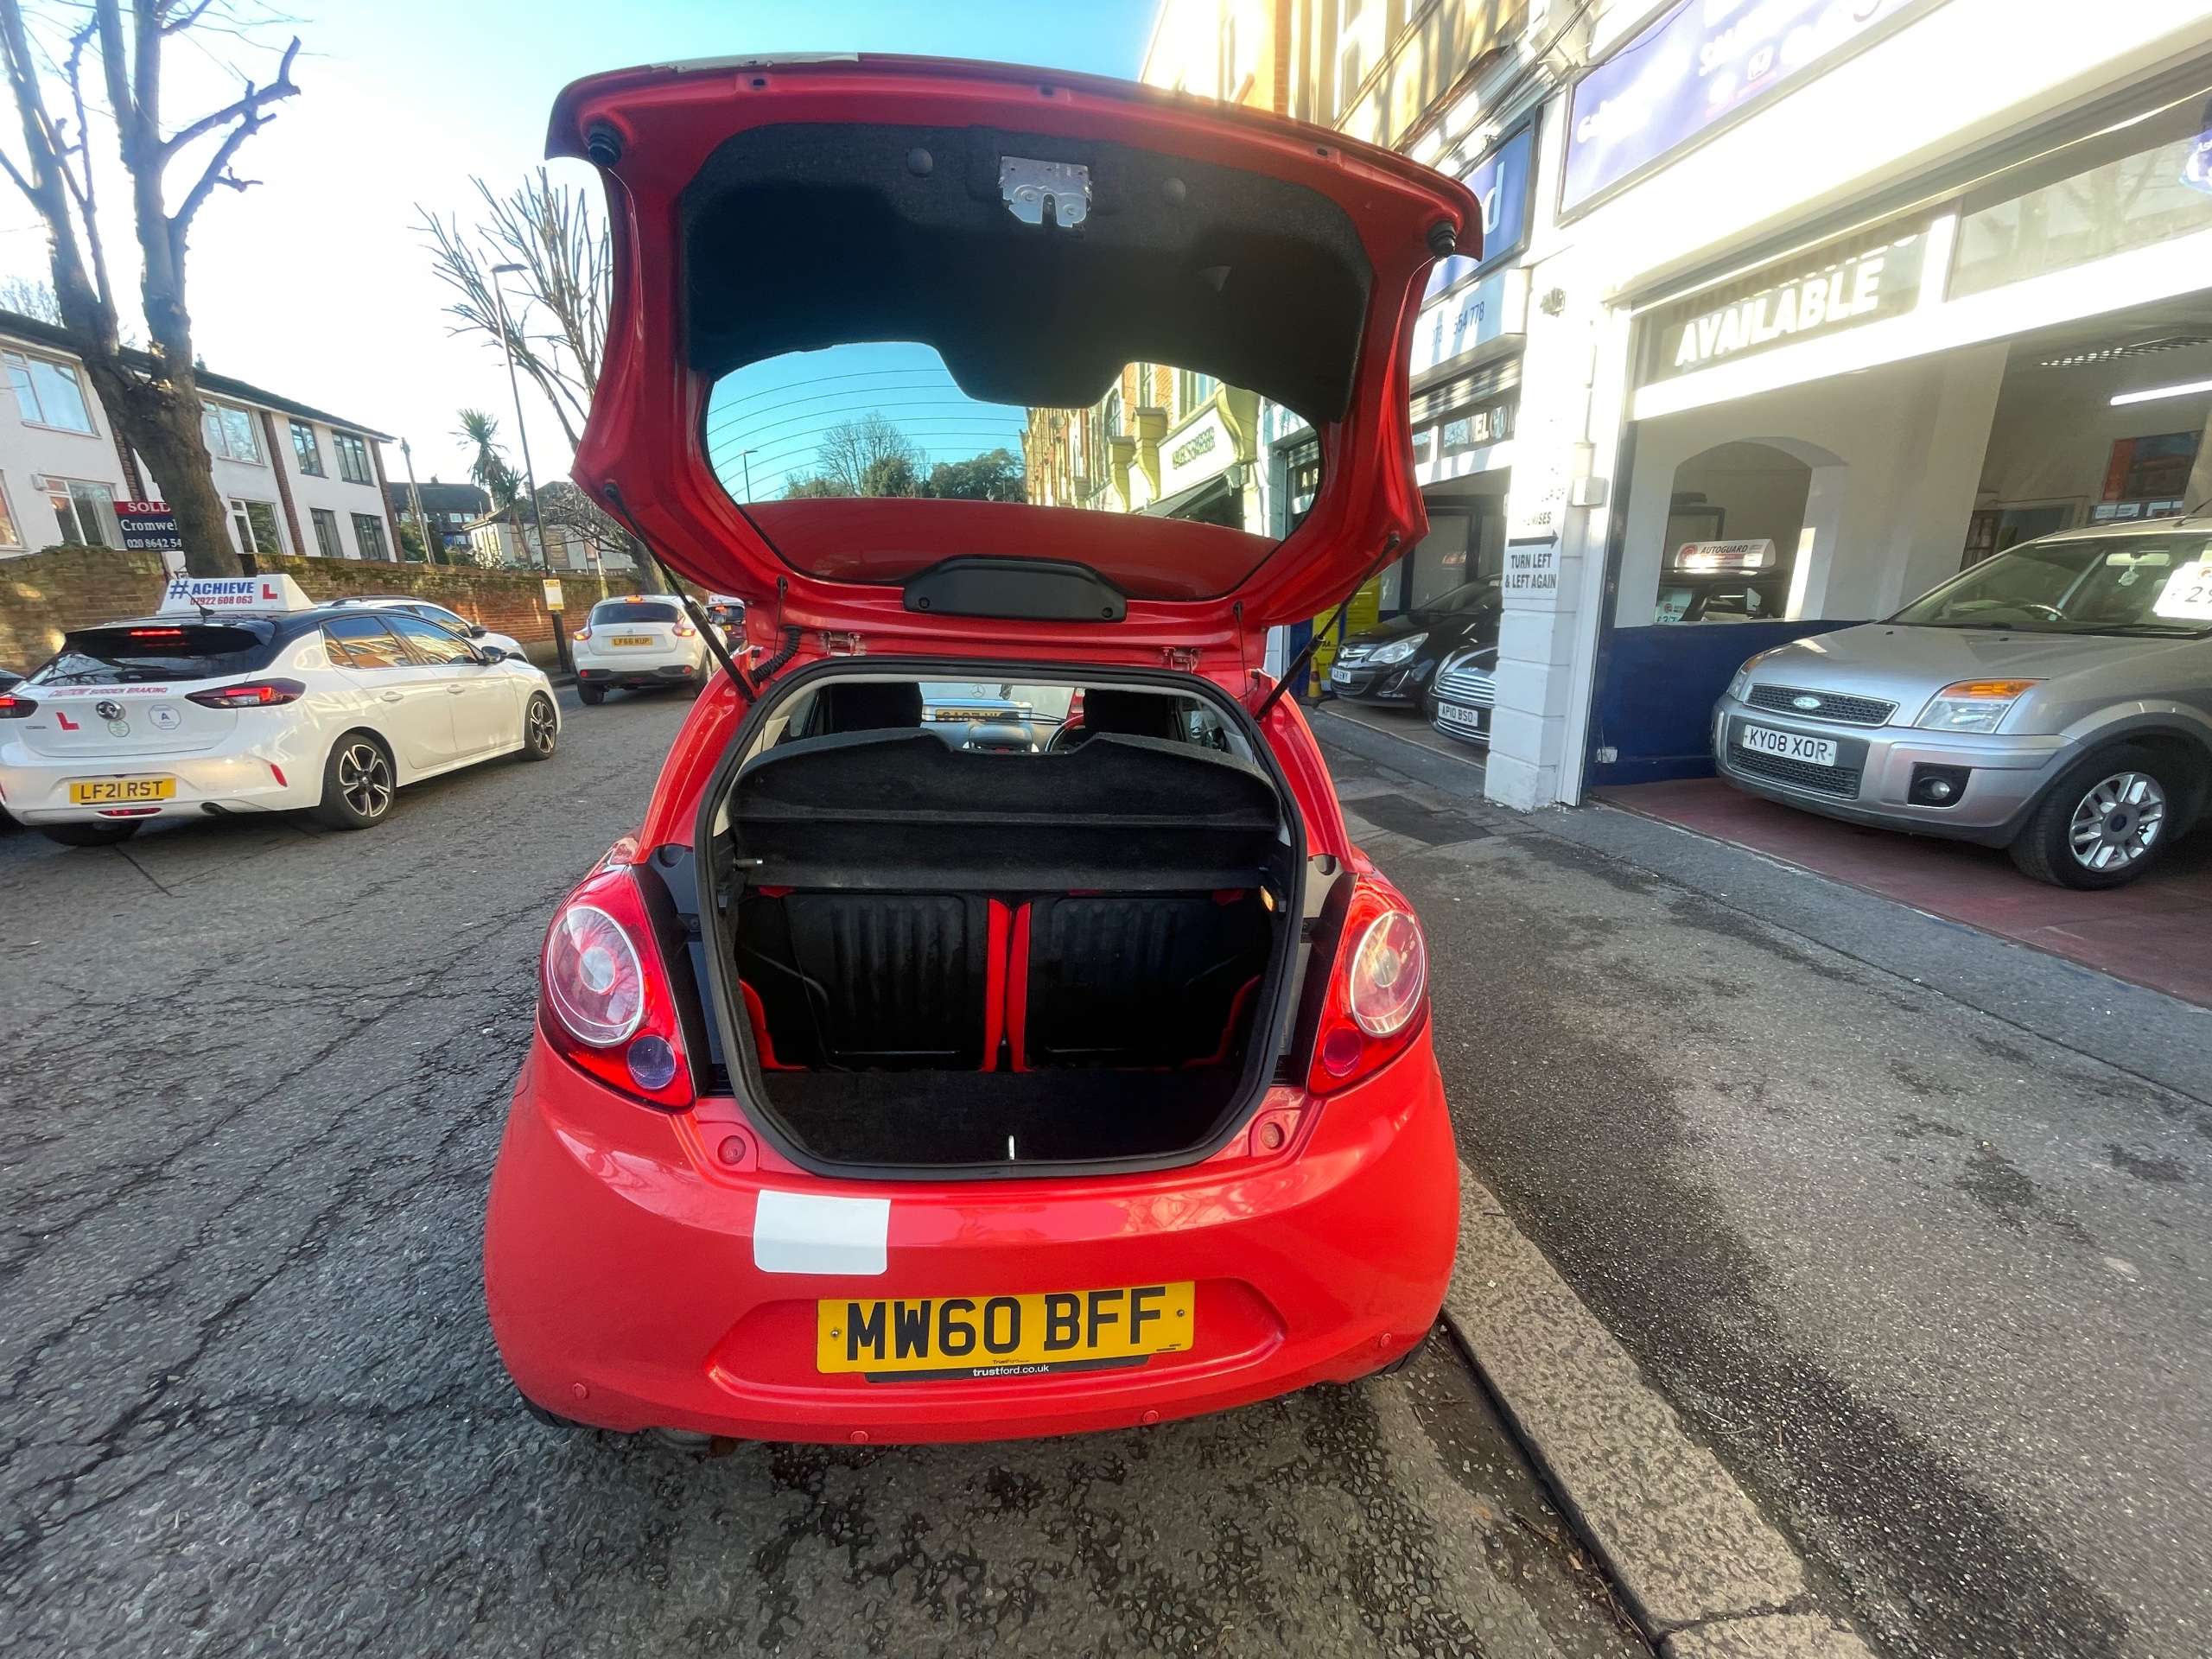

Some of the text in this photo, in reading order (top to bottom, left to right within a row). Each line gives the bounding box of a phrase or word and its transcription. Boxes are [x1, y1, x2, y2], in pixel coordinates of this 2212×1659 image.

[1470, 301, 1484, 327] 778
[1674, 257, 1885, 366] AVAILABLE
[128, 502, 171, 512] SOLD
[126, 538, 143, 548] 020
[144, 538, 169, 548] 8642
[1700, 544, 1749, 554] AUTOGUARD
[1511, 553, 1552, 569] TURN LEFT
[1504, 574, 1557, 588] & LEFT AGAIN
[262, 583, 278, 600] L
[217, 596, 234, 605] 608
[236, 595, 253, 604] 063
[1441, 703, 1456, 719] AP10
[55, 712, 79, 731] L
[1749, 728, 1827, 761] KY08 XOR
[80, 780, 163, 800] LF21 RST
[847, 1286, 1166, 1361] MW60 BFF
[973, 1364, 1050, 1376] trustford.co.uk
